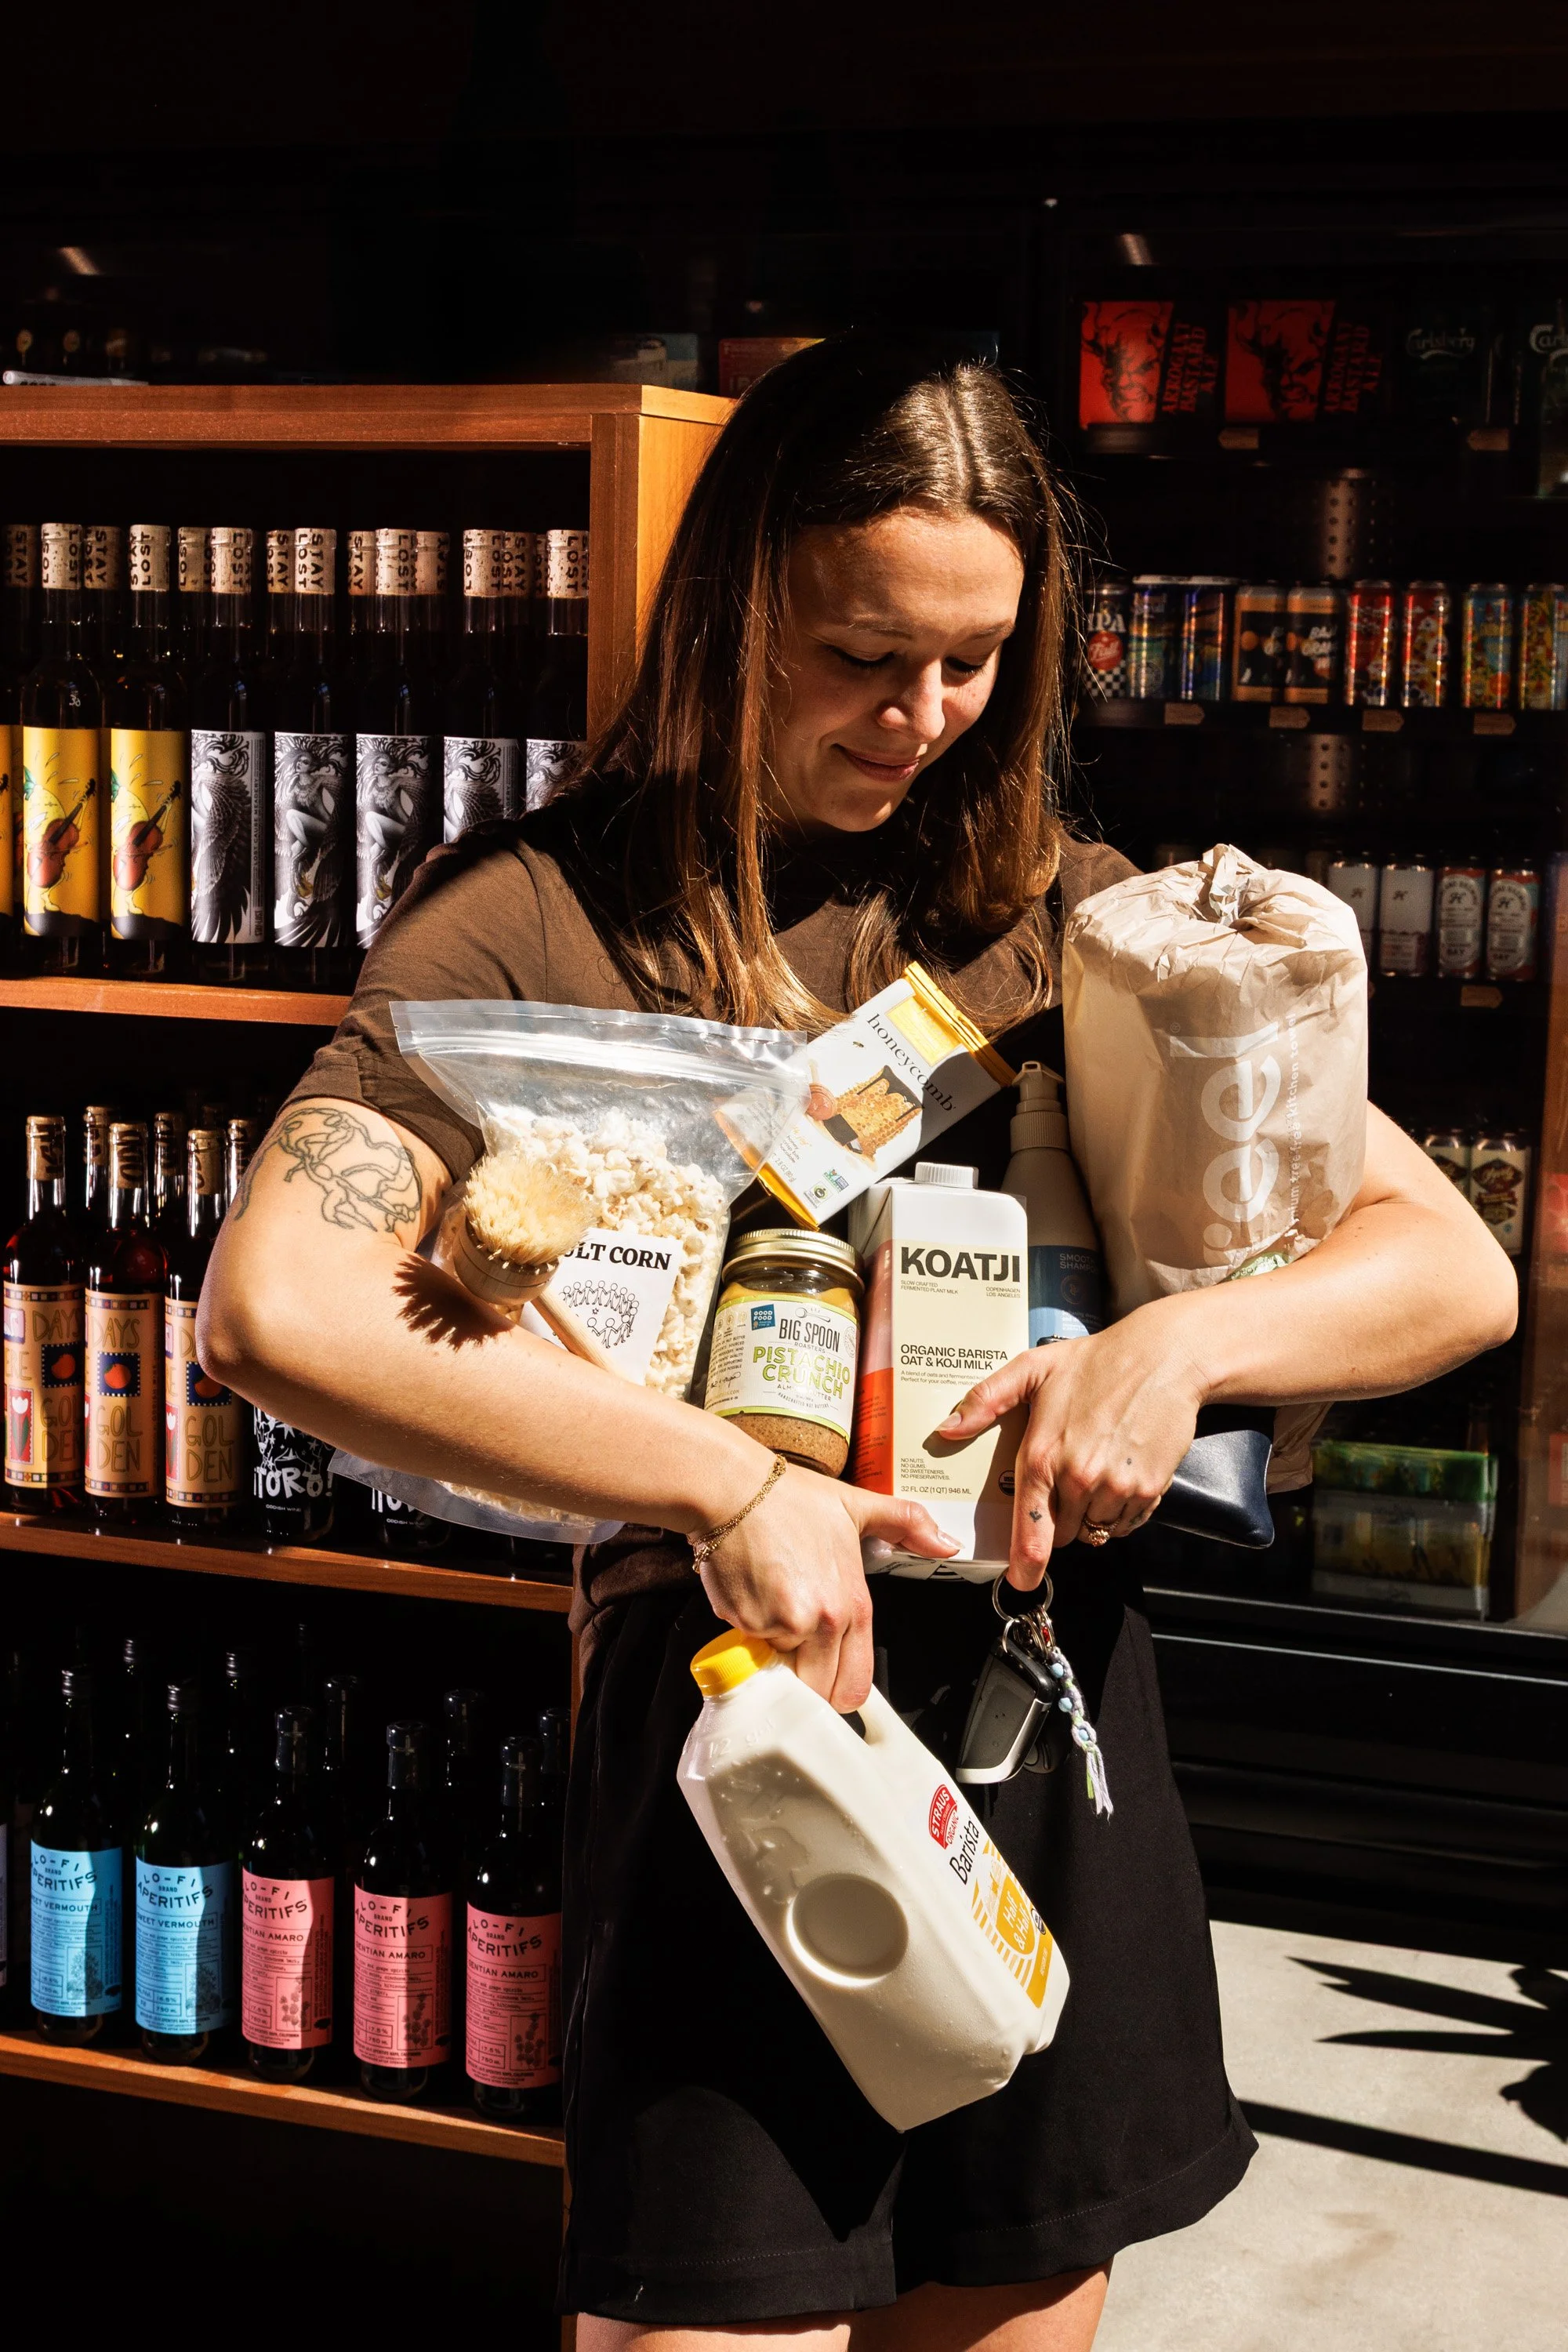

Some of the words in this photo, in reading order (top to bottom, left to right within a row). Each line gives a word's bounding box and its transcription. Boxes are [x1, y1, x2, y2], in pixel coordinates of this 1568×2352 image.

[68, 528, 79, 584] LOST
[95, 529, 107, 583] STAY
[140, 531, 151, 586] LOST
[179, 533, 187, 587] LOST
[232, 532, 244, 588] LOST
[276, 532, 289, 586] STAY
[298, 533, 308, 589] LOST
[310, 532, 324, 589] STAY
[353, 535, 363, 590] STAY
[397, 534, 409, 591] LOST
[464, 535, 473, 590] LOST
[491, 534, 501, 591] LOST
[514, 536, 525, 590] STAY
[566, 535, 579, 592] LOST
[1286, 1013, 1299, 1058] towel
[866, 1013, 953, 1112] honeycomb
[1286, 1062, 1299, 1116] kitchen
[609, 1246, 673, 1271] CORN
[901, 1247, 1021, 1283] KOATJI
[92, 1316, 140, 1349] DAYS
[779, 1319, 801, 1341] BIG
[804, 1322, 840, 1352] SPOON
[794, 1341, 826, 1354] ROASTERS
[753, 1346, 851, 1385] PISTACHIO
[901, 1344, 956, 1357] ORGANIC
[958, 1348, 1008, 1360] BARISTA
[901, 1355, 924, 1366] OAT
[925, 1357, 934, 1367] &
[936, 1358, 962, 1369] KOJI
[964, 1359, 993, 1370] MILK
[762, 1363, 844, 1399] CRUNCH
[778, 1392, 805, 1406] HANDCRAFTED
[96, 1405, 143, 1438] GOL
[185, 1414, 234, 1447] GOL
[97, 1439, 140, 1473] DEN
[186, 1449, 233, 1483] DEN
[932, 1789, 951, 1838] STRAUS
[946, 1811, 960, 1845] ORGANIC
[34, 1854, 80, 1872] LO-FI
[949, 1819, 980, 1886] Barista
[45, 1867, 62, 1876] BRAND
[143, 1872, 196, 1888] LO-FI
[44, 1900, 98, 1912] VERMOUTH
[137, 1882, 214, 1908] APERITIFS
[245, 1882, 290, 1900] LO-FI
[255, 1894, 272, 1904] BRAND
[158, 1918, 215, 1929] VERMOUTH
[354, 1907, 430, 1938] APERITIFS
[361, 1900, 412, 1919] LO-FI
[373, 1913, 393, 1922] BRAND
[1003, 1890, 1018, 1929] Half
[1015, 1902, 1030, 1939] Half
[267, 1933, 304, 1942] AMARO
[473, 1918, 524, 1937] LO-FI
[486, 1932, 505, 1941] BRAND
[1013, 1932, 1025, 1951] &
[388, 1951, 426, 1959] AMARO
[501, 1970, 539, 1979] AMARO
